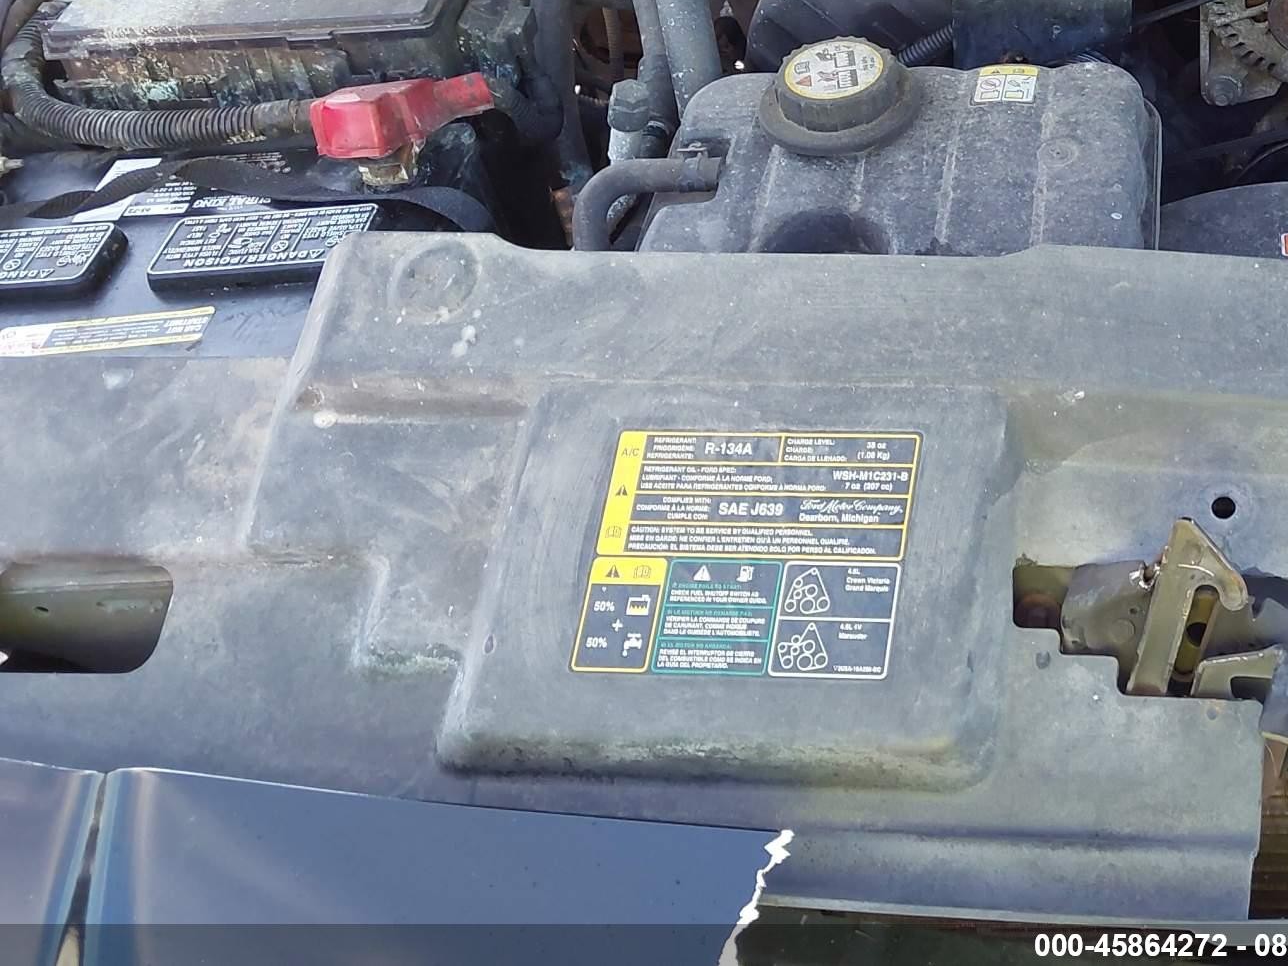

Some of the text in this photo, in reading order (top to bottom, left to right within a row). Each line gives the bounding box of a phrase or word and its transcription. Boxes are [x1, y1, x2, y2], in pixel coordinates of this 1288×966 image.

[182, 250, 309, 267] DANGER/POISON
[621, 448, 640, 457] A/C
[704, 441, 753, 455] R-134A
[832, 470, 909, 482] WSH-M1C231-B
[718, 502, 784, 516] SAE J639
[800, 499, 824, 511] Ford
[821, 500, 853, 513] Motor
[799, 513, 879, 524] Dearborn, Michigan
[593, 601, 615, 611] 50%
[585, 637, 607, 648] 50%
